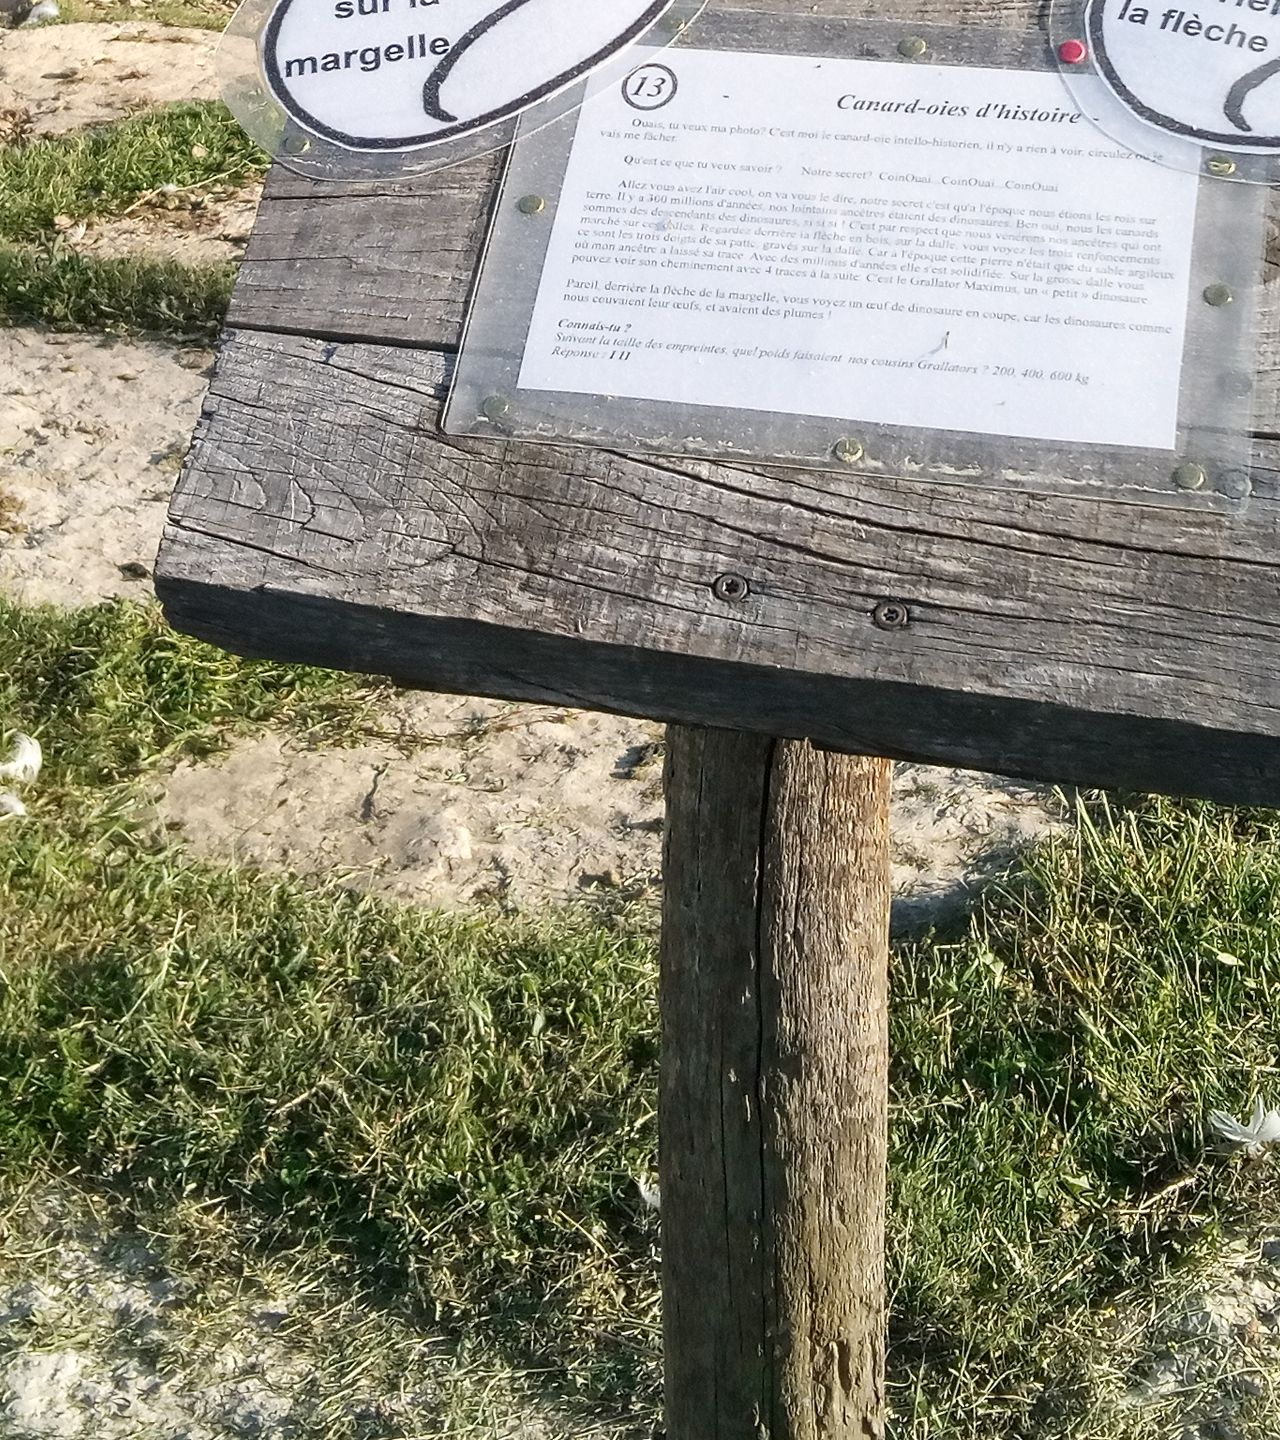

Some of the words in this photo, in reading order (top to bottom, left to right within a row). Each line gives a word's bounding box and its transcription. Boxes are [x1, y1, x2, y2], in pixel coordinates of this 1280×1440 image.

[1159, 8, 1269, 52] flèche
[285, 33, 451, 79] margelle
[631, 75, 666, 98] 13
[837, 94, 969, 117] Canard-oies
[976, 102, 1081, 124] d'histoire
[599, 130, 621, 138] vais
[668, 121, 680, 129] tu
[681, 123, 708, 131] veux
[728, 125, 766, 136] photo?
[768, 127, 795, 137] C'est
[833, 133, 891, 143] canard-oie
[986, 141, 994, 150] il
[996, 142, 1013, 154] n'y
[1025, 145, 1048, 153] rien
[622, 154, 658, 166] Qu'est
[673, 160, 695, 169] que
[696, 160, 708, 168] tu
[709, 162, 737, 170] veux
[739, 164, 773, 173] savoir
[800, 166, 832, 176] Notre
[834, 170, 873, 179] secret?
[616, 192, 626, 200] Il
[669, 196, 714, 207] millions
[768, 204, 788, 212] nos
[1066, 225, 1093, 234] nous
[1115, 229, 1159, 238] canards
[618, 178, 648, 189] Allez
[649, 183, 675, 191] vous
[677, 185, 703, 193] avez
[705, 184, 726, 194] l'air
[790, 193, 816, 201] vous
[859, 197, 888, 206] notre
[891, 200, 924, 208] secret
[1028, 209, 1055, 218] nous
[1114, 215, 1136, 223] rois
[582, 204, 627, 213] sommes
[629, 205, 648, 215] des
[899, 226, 939, 237] respect
[591, 242, 616, 250] mon
[749, 252, 777, 263] Avec
[1045, 276, 1082, 287] grosse
[1085, 277, 1113, 288] dalle
[592, 229, 616, 237] sont
[635, 231, 660, 241] trois
[698, 235, 712, 244] de
[949, 255, 977, 264] cette
[979, 257, 1013, 268] pierre
[1052, 264, 1073, 274] que
[1128, 268, 1175, 280] argileux
[1076, 252, 1160, 266] renfoncements
[571, 253, 612, 263] pouvez
[613, 256, 636, 265] voir
[659, 258, 734, 272] cheminement
[735, 266, 761, 274] avec
[774, 268, 807, 278] traces
[819, 270, 830, 280] la
[909, 277, 960, 290] Grallator
[1023, 288, 1038, 296] un
[1051, 290, 1078, 301] petit
[557, 318, 621, 332] Connais-tu
[562, 294, 589, 302] nous
[591, 296, 645, 306] couvaient
[704, 303, 716, 311] et
[718, 305, 759, 314] avaient
[761, 306, 781, 316] des
[782, 308, 824, 320] plumes
[649, 285, 660, 294] la
[698, 288, 712, 298] de
[714, 290, 726, 299] la
[782, 297, 809, 306] vous
[811, 299, 846, 311] voyez
[848, 302, 863, 310] un
[890, 303, 905, 313] de
[907, 304, 962, 318] dinosaure
[964, 311, 979, 319] en
[1022, 316, 1041, 324] car
[1044, 315, 1061, 325] les
[1063, 316, 1126, 330] dinosaures
[1128, 324, 1172, 334] comme
[554, 331, 597, 344] Suivant
[598, 335, 610, 345] la
[612, 337, 642, 347] taille
[644, 339, 663, 349] des
[731, 347, 758, 358] quel
[757, 349, 790, 360] poids
[790, 350, 842, 364] faisaient
[847, 357, 869, 366] nos
[870, 359, 914, 369] cousins
[916, 360, 978, 375] Grallators
[1049, 371, 1073, 382] 600
[1074, 373, 1089, 387] kg
